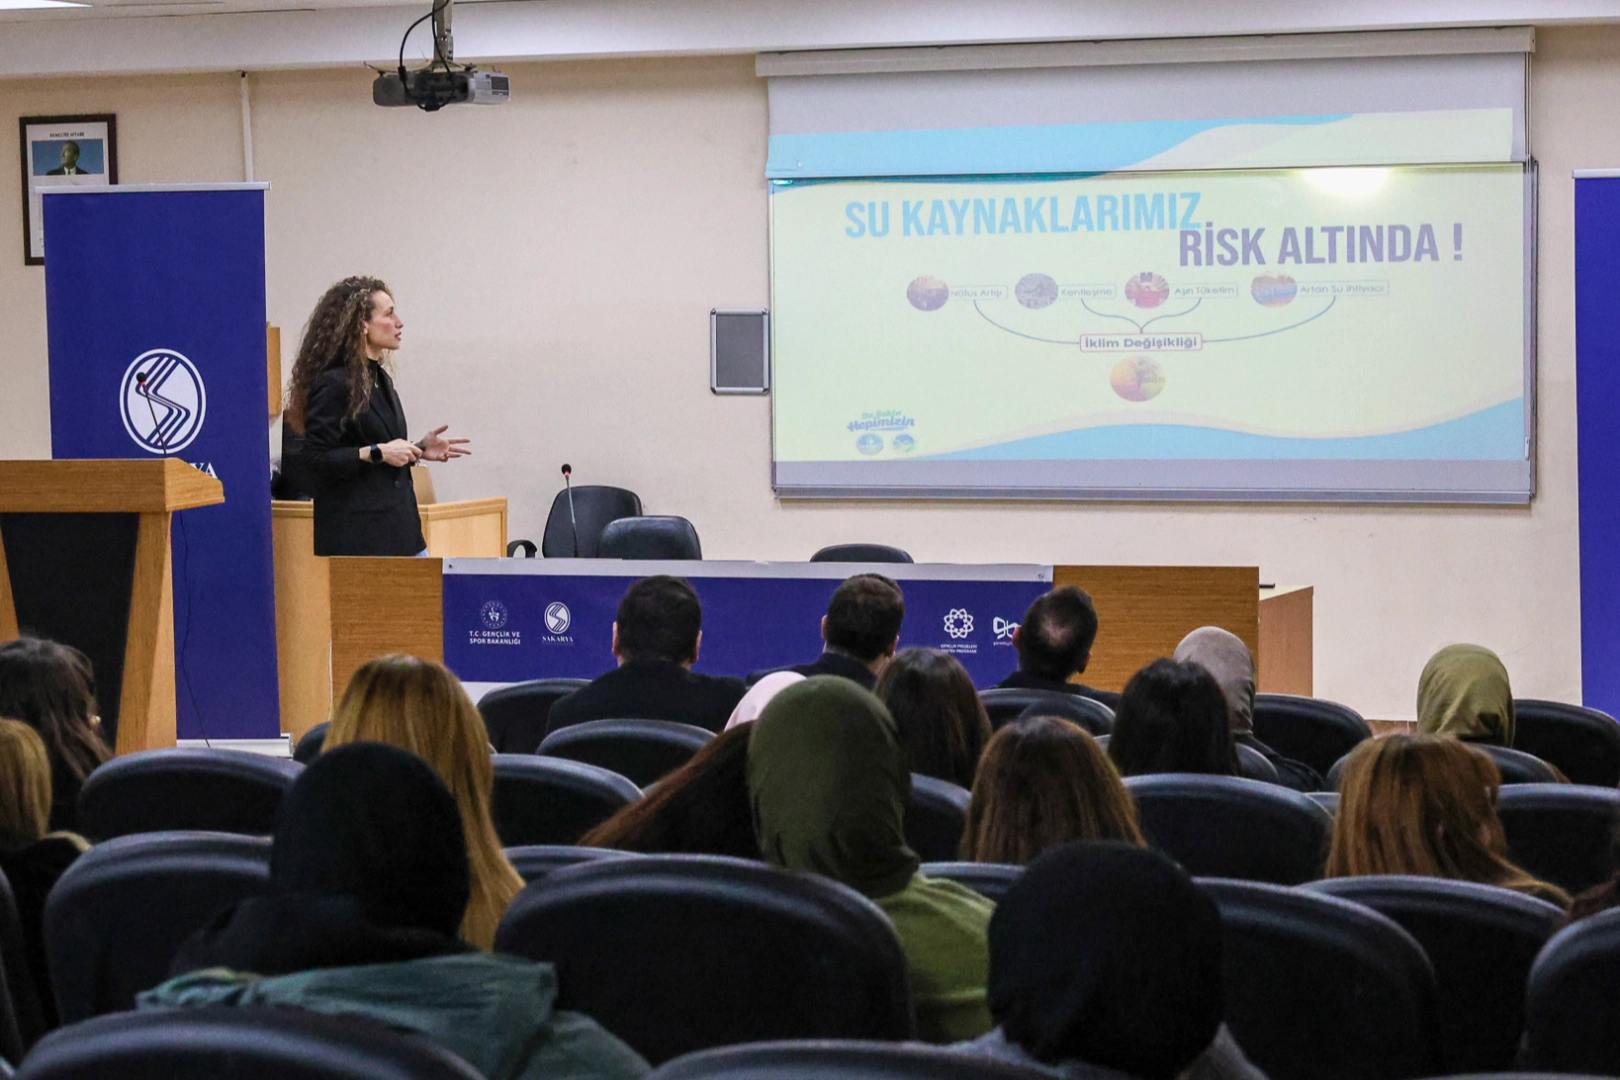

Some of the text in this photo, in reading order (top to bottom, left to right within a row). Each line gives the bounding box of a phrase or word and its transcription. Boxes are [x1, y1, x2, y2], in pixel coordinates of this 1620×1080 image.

[844, 192, 1202, 238] SU KAYNAKLARIMIZ
[1179, 221, 1463, 267] RİSK ALTINDA !
[1061, 288, 1113, 298] Kentleşme
[1195, 285, 1235, 295] Tüketim
[1300, 285, 1329, 294] Artan
[1331, 285, 1344, 293] Su
[1084, 336, 1198, 350] İklim Değişikliği
[482, 630, 510, 639] GENÇLİK
[487, 638, 521, 646] BAKANLIĞI
